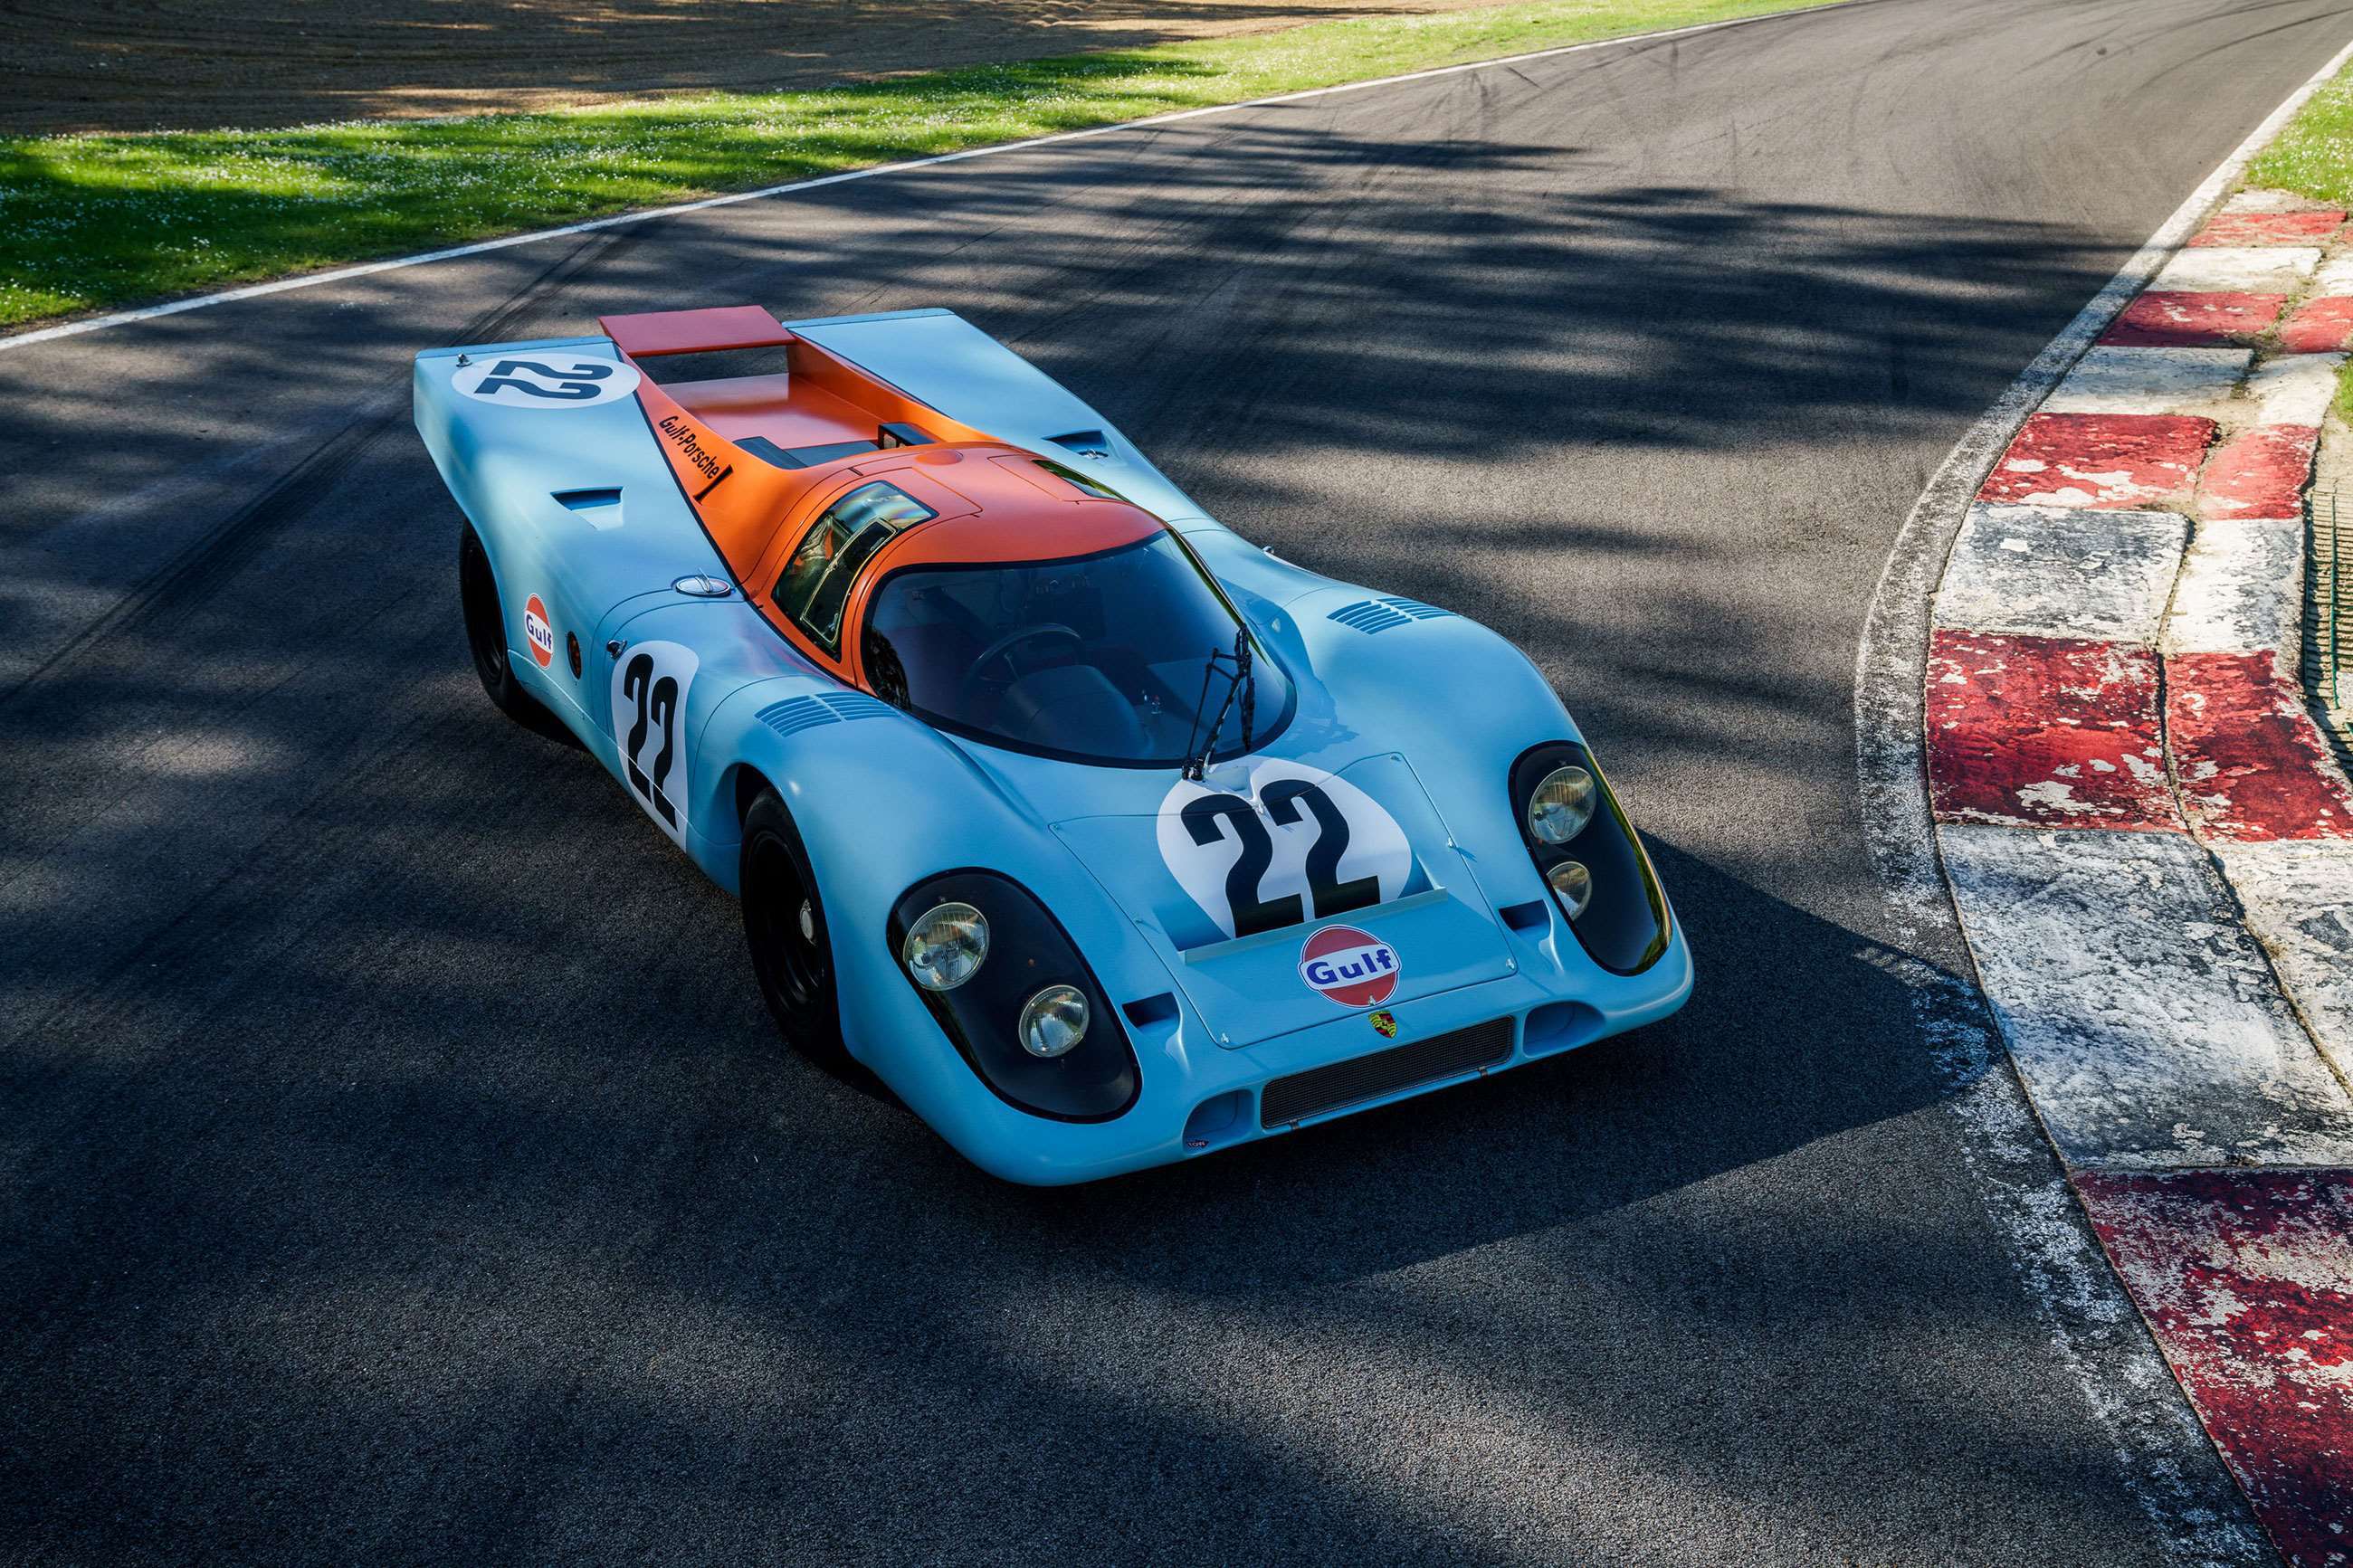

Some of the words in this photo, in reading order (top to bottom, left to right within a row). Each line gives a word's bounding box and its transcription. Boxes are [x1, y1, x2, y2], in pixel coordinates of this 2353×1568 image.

[473, 360, 614, 400] 22
[659, 415, 719, 479] Gulf-Porsche
[526, 613, 552, 650] Gulf
[624, 652, 679, 833] 22
[1180, 779, 1381, 938] 22
[1306, 948, 1392, 985] Gulf
